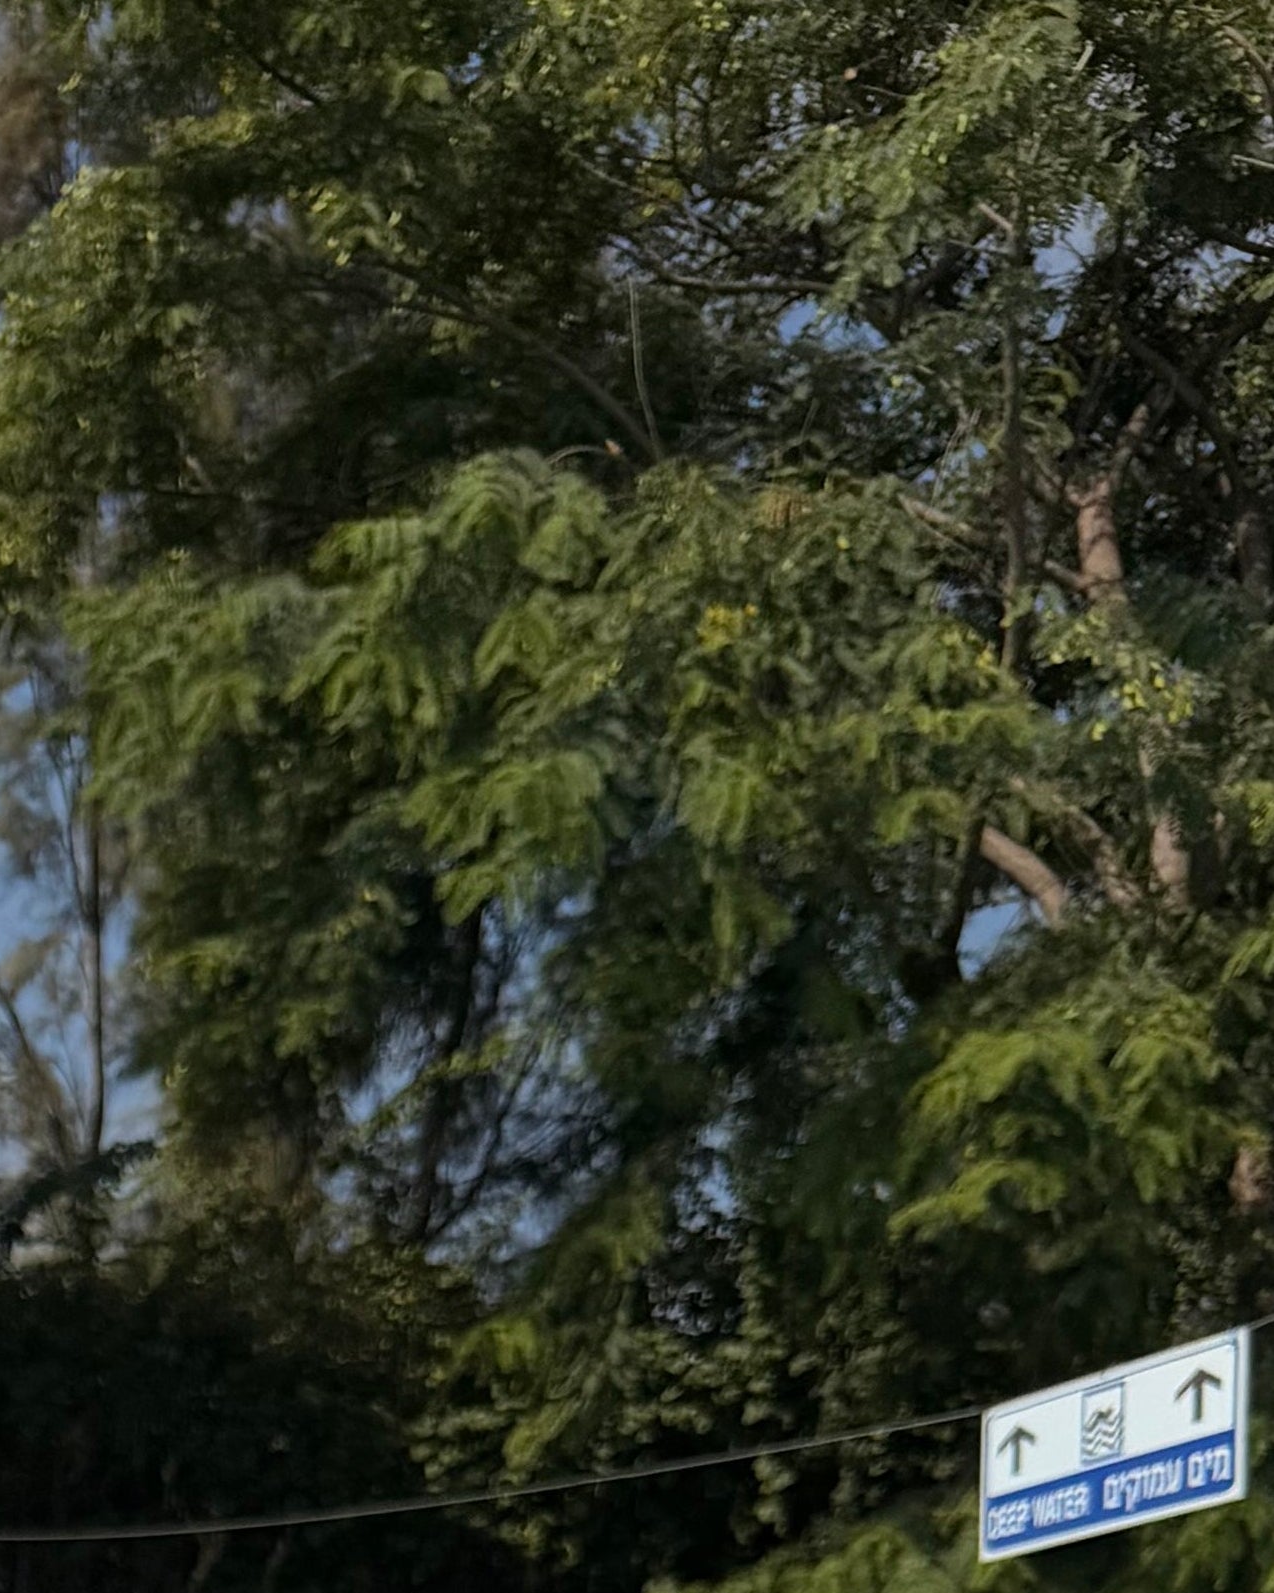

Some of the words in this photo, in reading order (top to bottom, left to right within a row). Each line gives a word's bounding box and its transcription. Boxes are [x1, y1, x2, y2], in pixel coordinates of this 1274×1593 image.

[1102, 1458, 1185, 1513] עמוקים
[1187, 1446, 1232, 1488] מים
[987, 1499, 1030, 1540] DEEP
[1033, 1483, 1090, 1529] WATER
